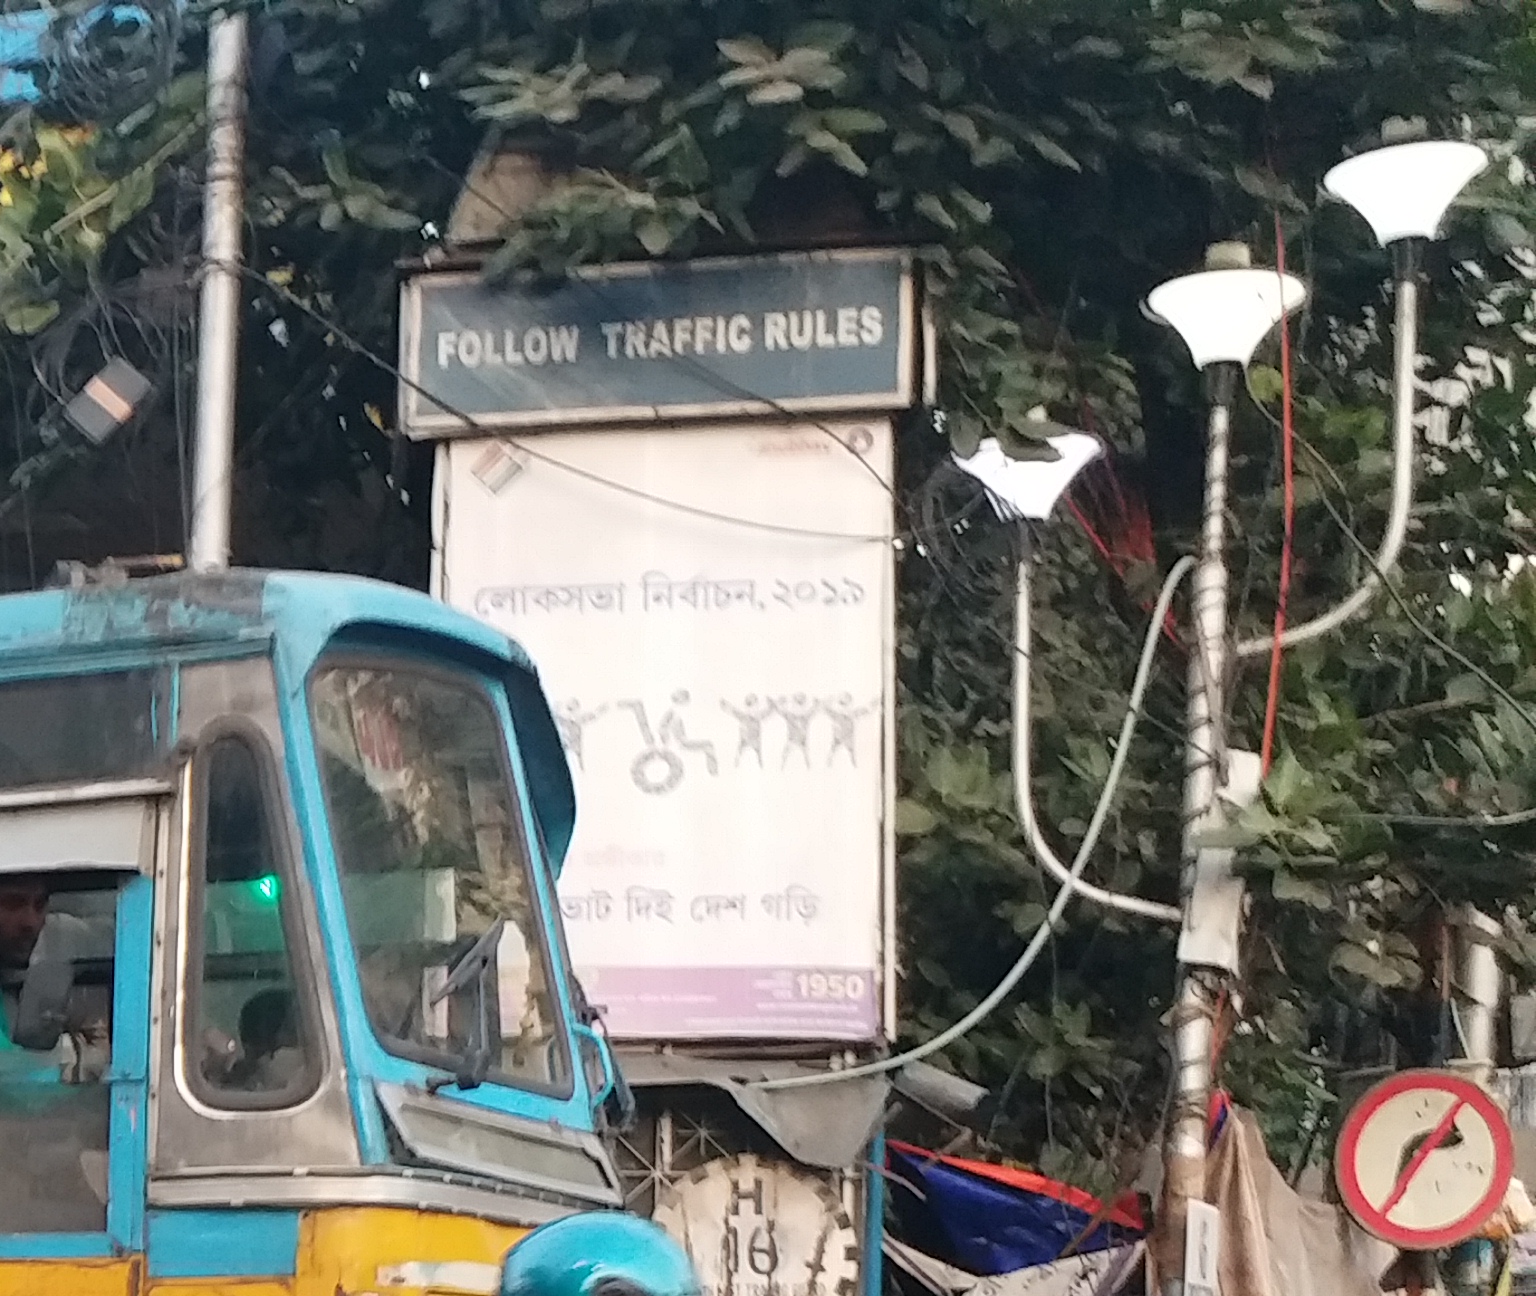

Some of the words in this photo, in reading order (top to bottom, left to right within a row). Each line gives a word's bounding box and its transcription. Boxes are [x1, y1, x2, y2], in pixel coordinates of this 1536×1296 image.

[437, 325, 579, 369] FOLLOW
[601, 313, 754, 361] TRAFFIC
[764, 305, 884, 352] RULES
[474, 578, 627, 618] লোকসভা
[771, 577, 866, 611] ২০১৯
[796, 973, 865, 999] 1950
